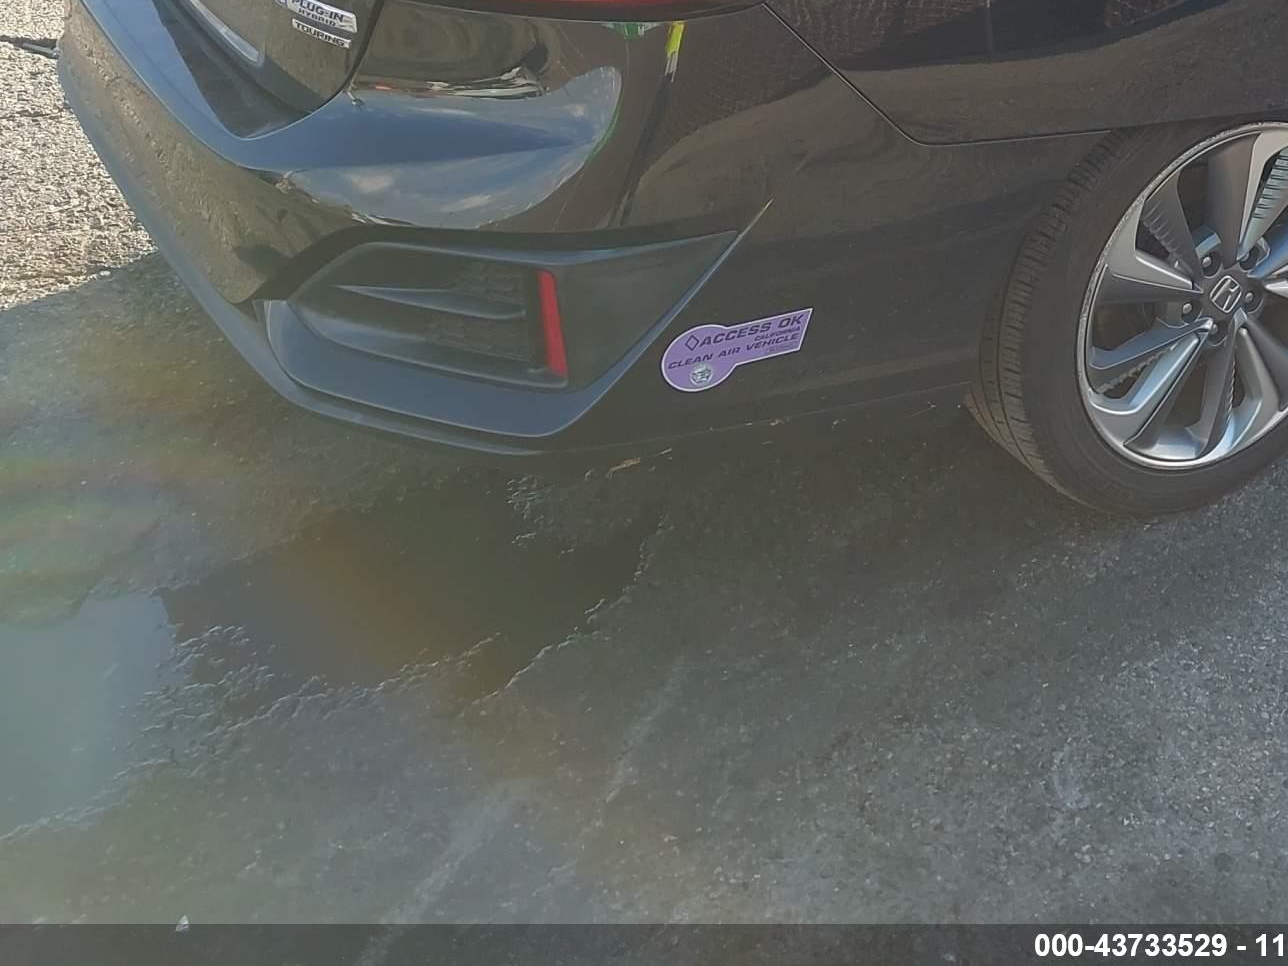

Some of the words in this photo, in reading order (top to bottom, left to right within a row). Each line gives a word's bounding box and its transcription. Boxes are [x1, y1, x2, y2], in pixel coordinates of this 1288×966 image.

[298, 8, 337, 27] HYBRID
[294, 20, 346, 47] TOURING
[699, 321, 772, 348] ACCESS
[778, 314, 805, 330] OK
[754, 325, 802, 342] CALIFORNIA
[667, 353, 714, 370] CLEAN
[717, 346, 741, 359] AIR
[746, 332, 801, 352] VEHICLE
